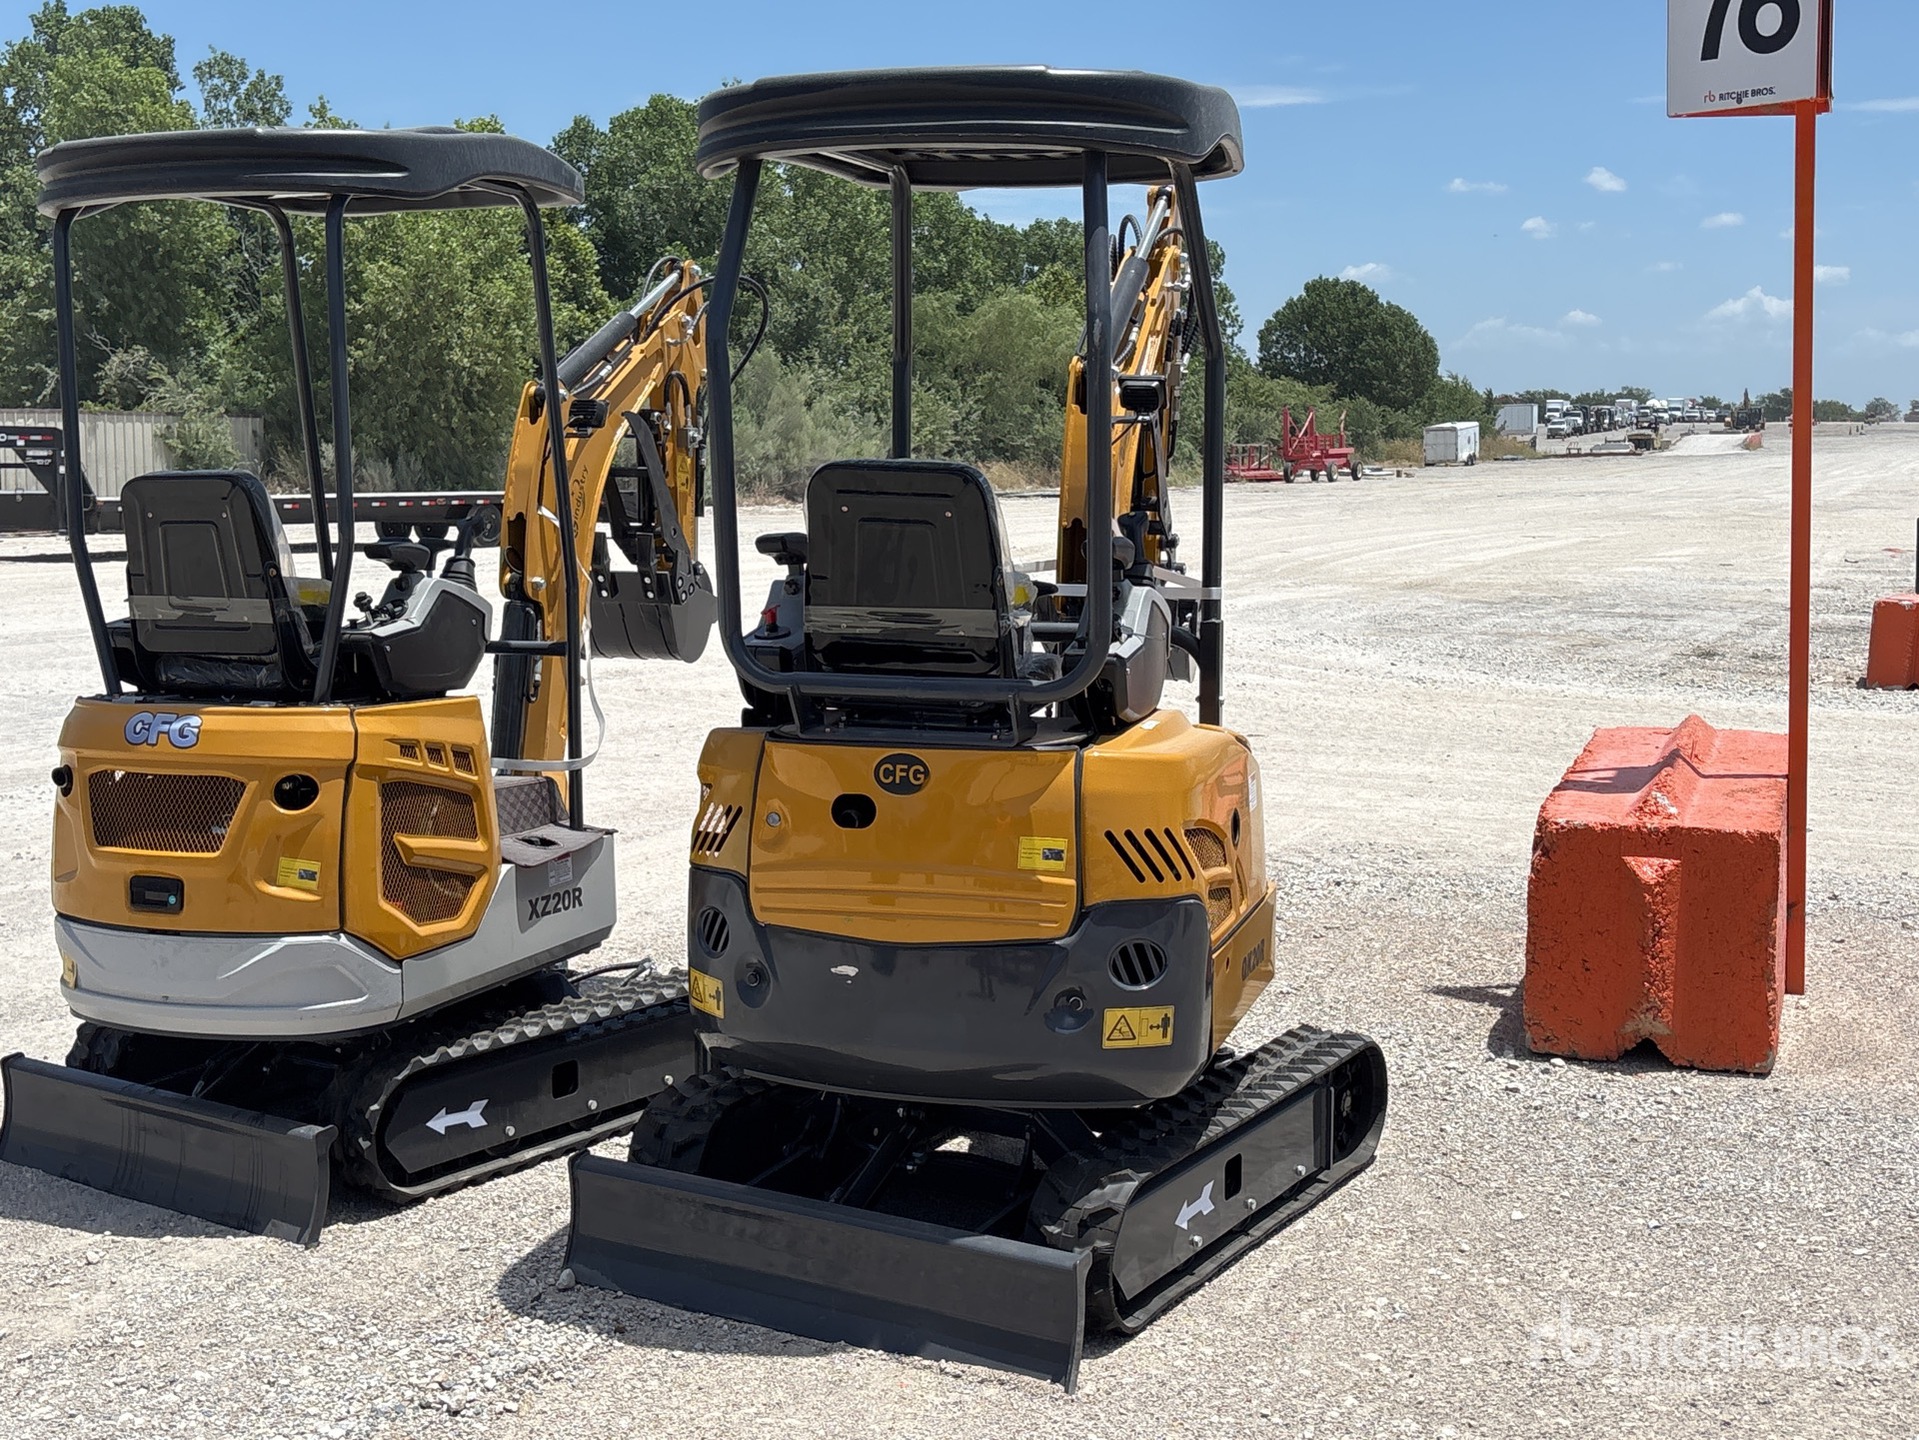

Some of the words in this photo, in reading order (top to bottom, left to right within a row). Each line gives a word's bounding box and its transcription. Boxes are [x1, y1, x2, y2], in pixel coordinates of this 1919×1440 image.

[1718, 89, 1750, 102] RITCHIE
[124, 710, 203, 750] CFG
[878, 763, 926, 786] CFG
[528, 886, 583, 921] XZ20R
